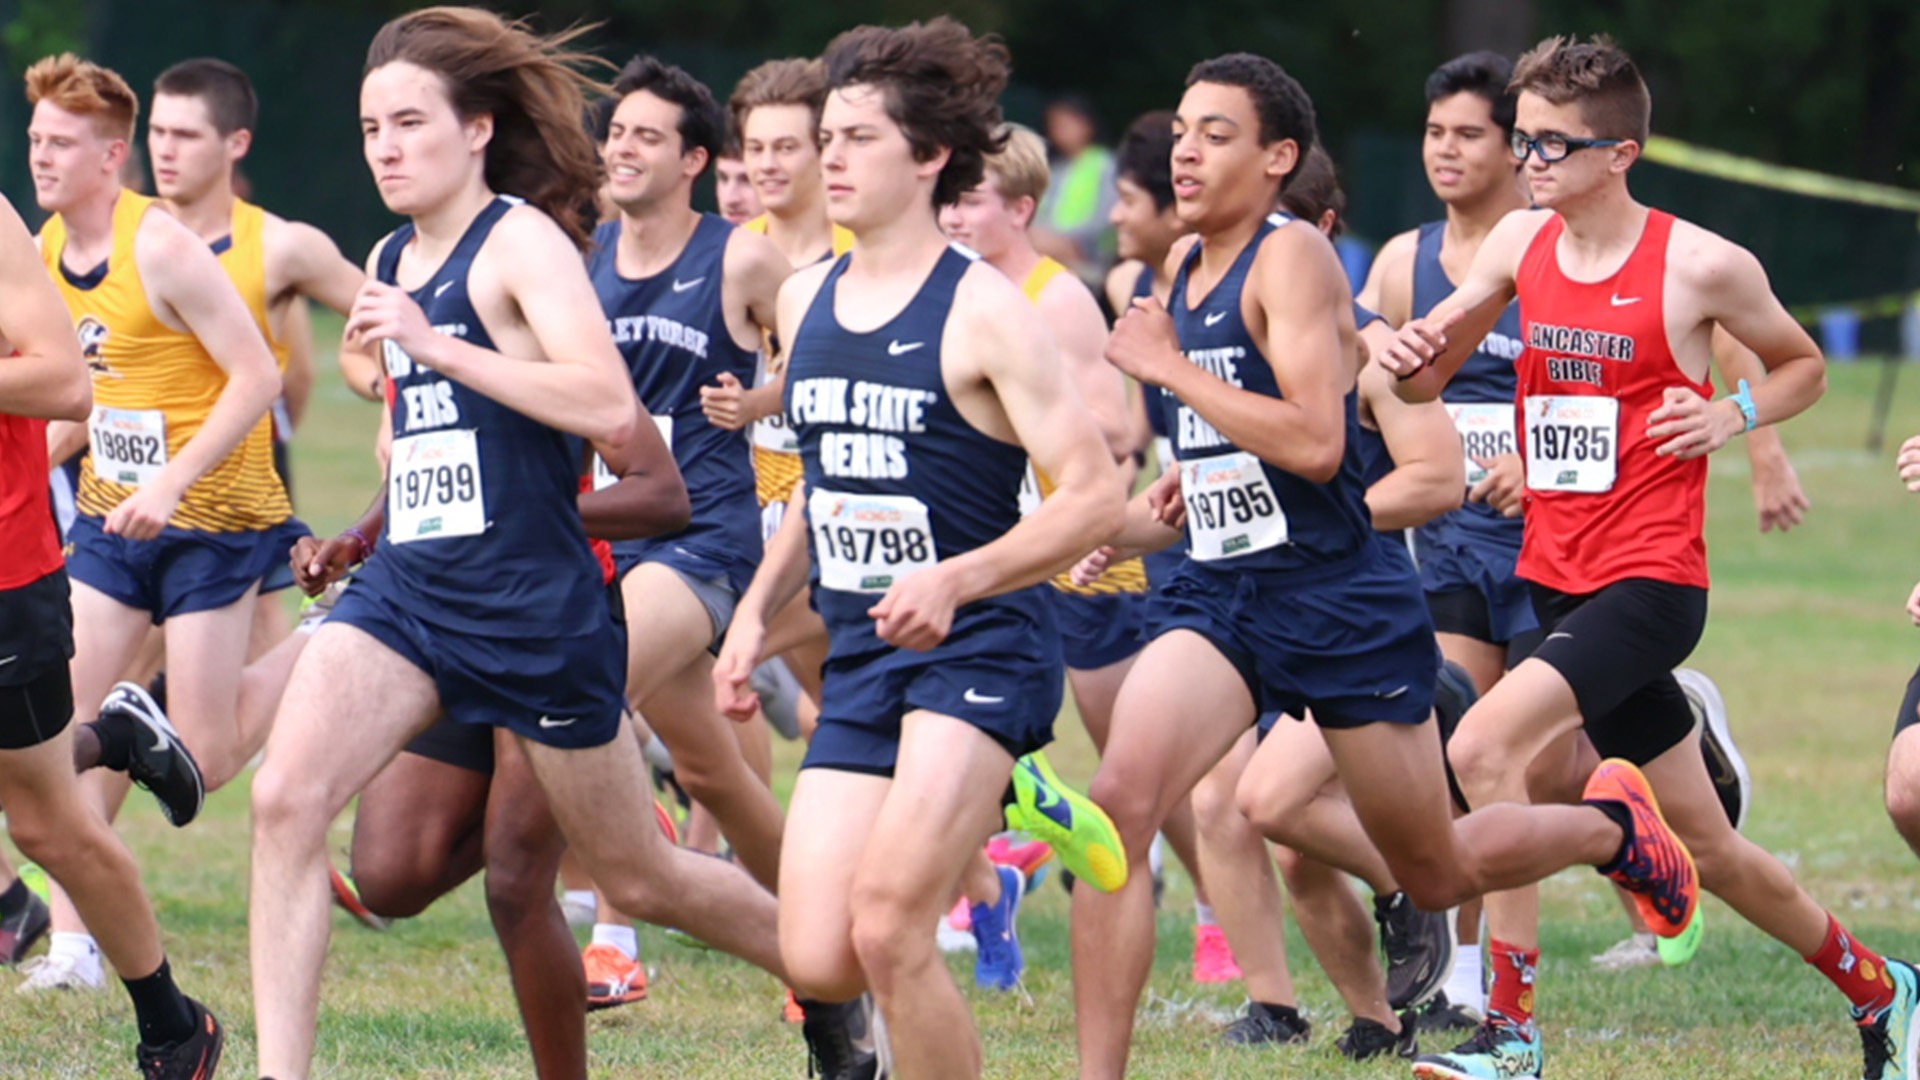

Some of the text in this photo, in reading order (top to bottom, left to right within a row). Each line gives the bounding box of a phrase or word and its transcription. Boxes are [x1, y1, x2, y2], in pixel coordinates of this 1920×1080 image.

[646, 315, 709, 359] FORGE
[1527, 321, 1634, 361] LANCASTER
[1546, 356, 1603, 388] BIBLE
[791, 377, 849, 425] PENN
[93, 427, 162, 467] 19862
[820, 432, 908, 480] BERKS
[1531, 424, 1610, 462] 19735
[395, 462, 475, 511] 19799
[1188, 480, 1275, 530] 19795
[820, 523, 929, 566] 19798
